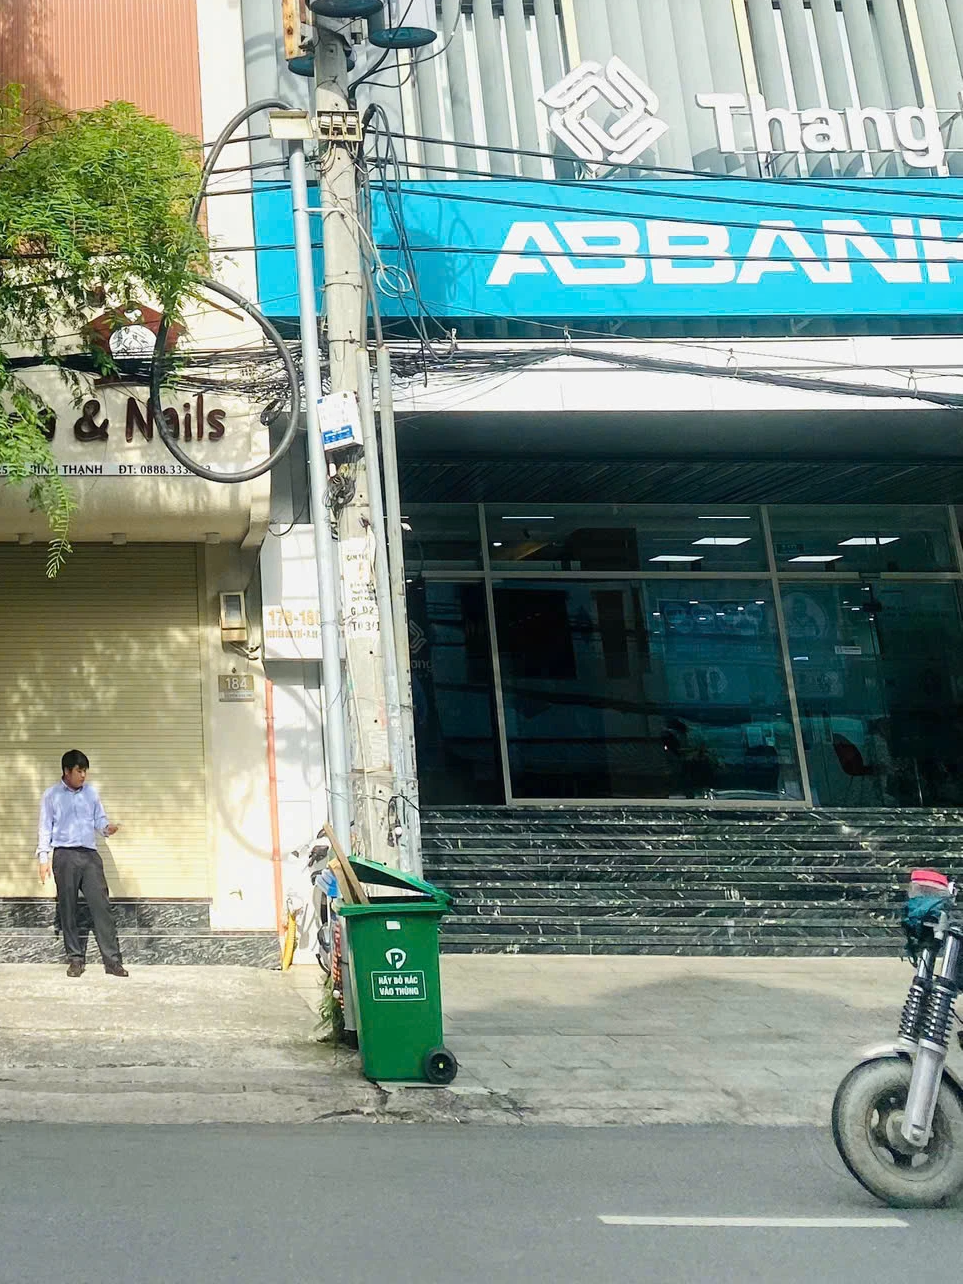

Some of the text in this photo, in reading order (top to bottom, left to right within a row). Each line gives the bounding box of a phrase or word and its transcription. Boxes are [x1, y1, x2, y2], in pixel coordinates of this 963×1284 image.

[694, 92, 946, 169] Thang
[74, 399, 110, 443] &
[125, 392, 227, 444] Nails
[63, 465, 103, 476] THẠNH
[119, 465, 136, 475] ĐT:
[225, 677, 248, 690] 184
